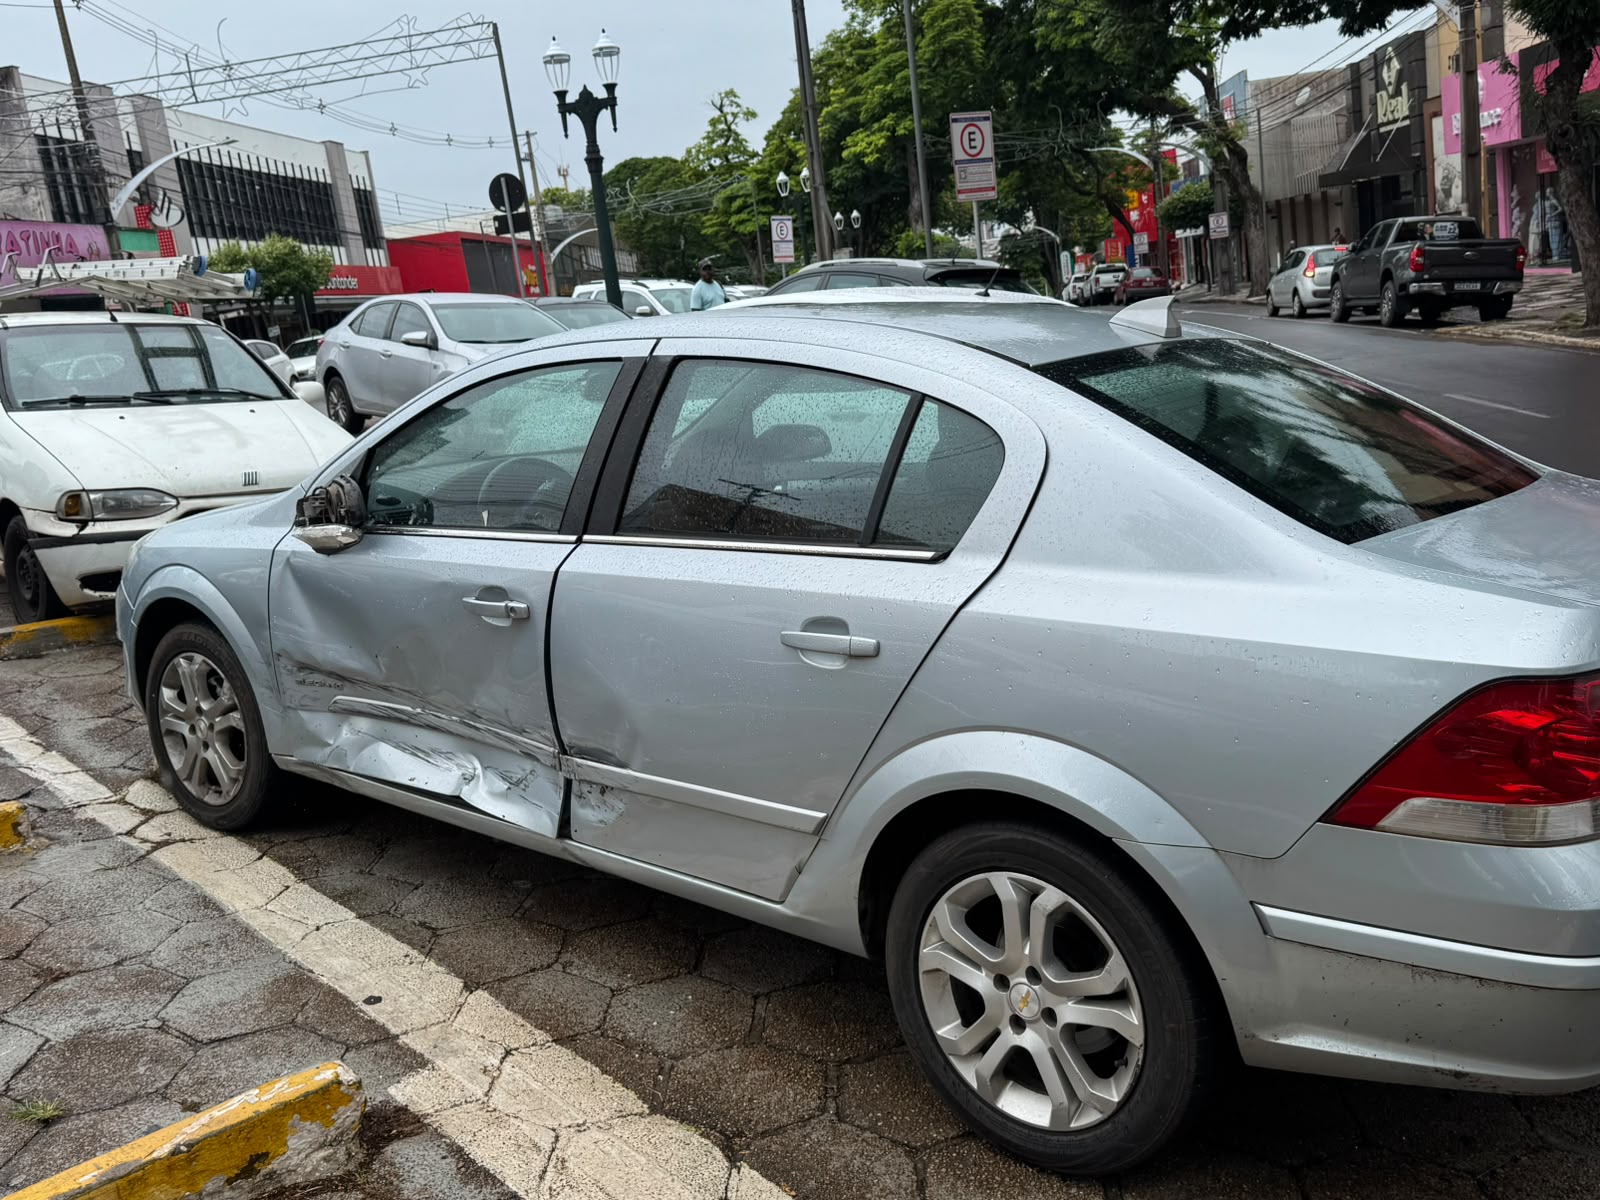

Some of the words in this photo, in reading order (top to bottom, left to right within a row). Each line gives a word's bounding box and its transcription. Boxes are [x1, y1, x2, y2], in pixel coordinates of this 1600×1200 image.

[1376, 82, 1410, 124] Real
[968, 131, 977, 149] E
[780, 225, 785, 236] E
[0, 229, 80, 257] ATINHA
